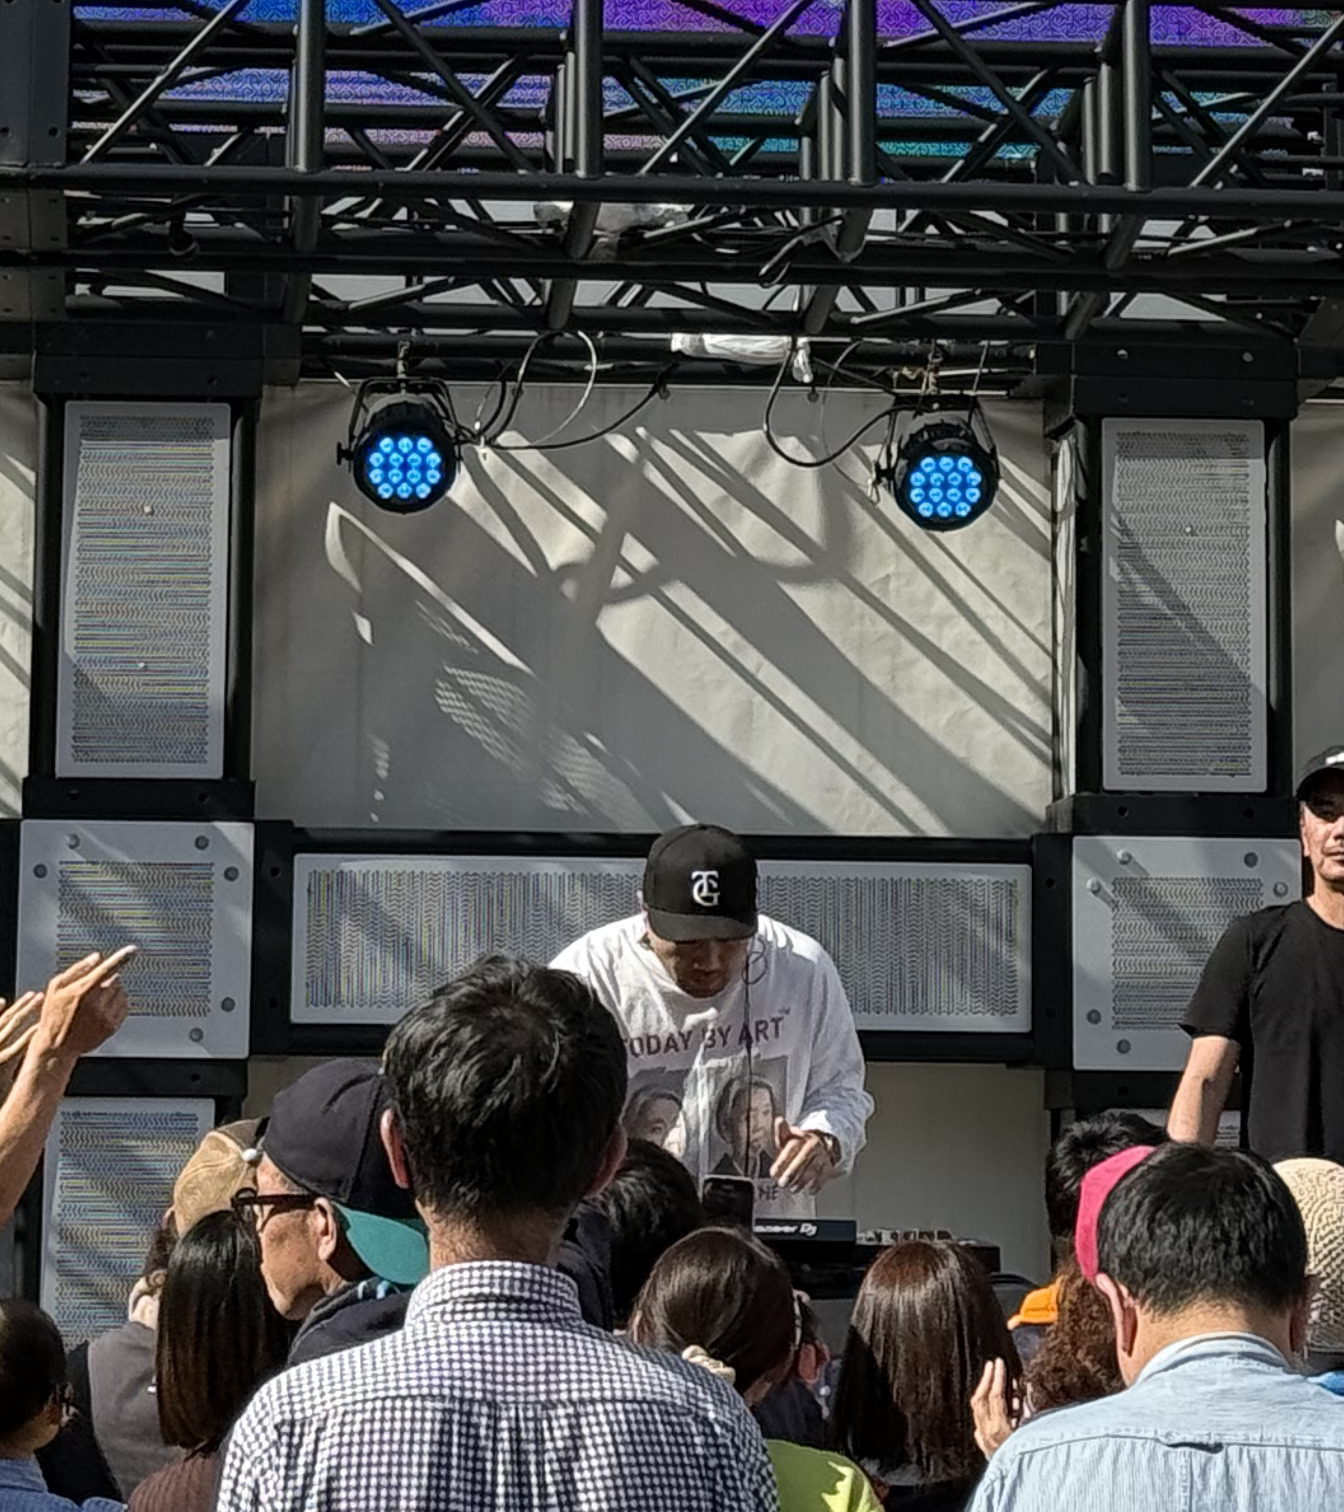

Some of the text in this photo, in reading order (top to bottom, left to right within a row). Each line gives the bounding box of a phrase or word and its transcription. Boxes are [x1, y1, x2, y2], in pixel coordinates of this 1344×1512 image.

[624, 1015, 785, 1058] ODAY BY ART
